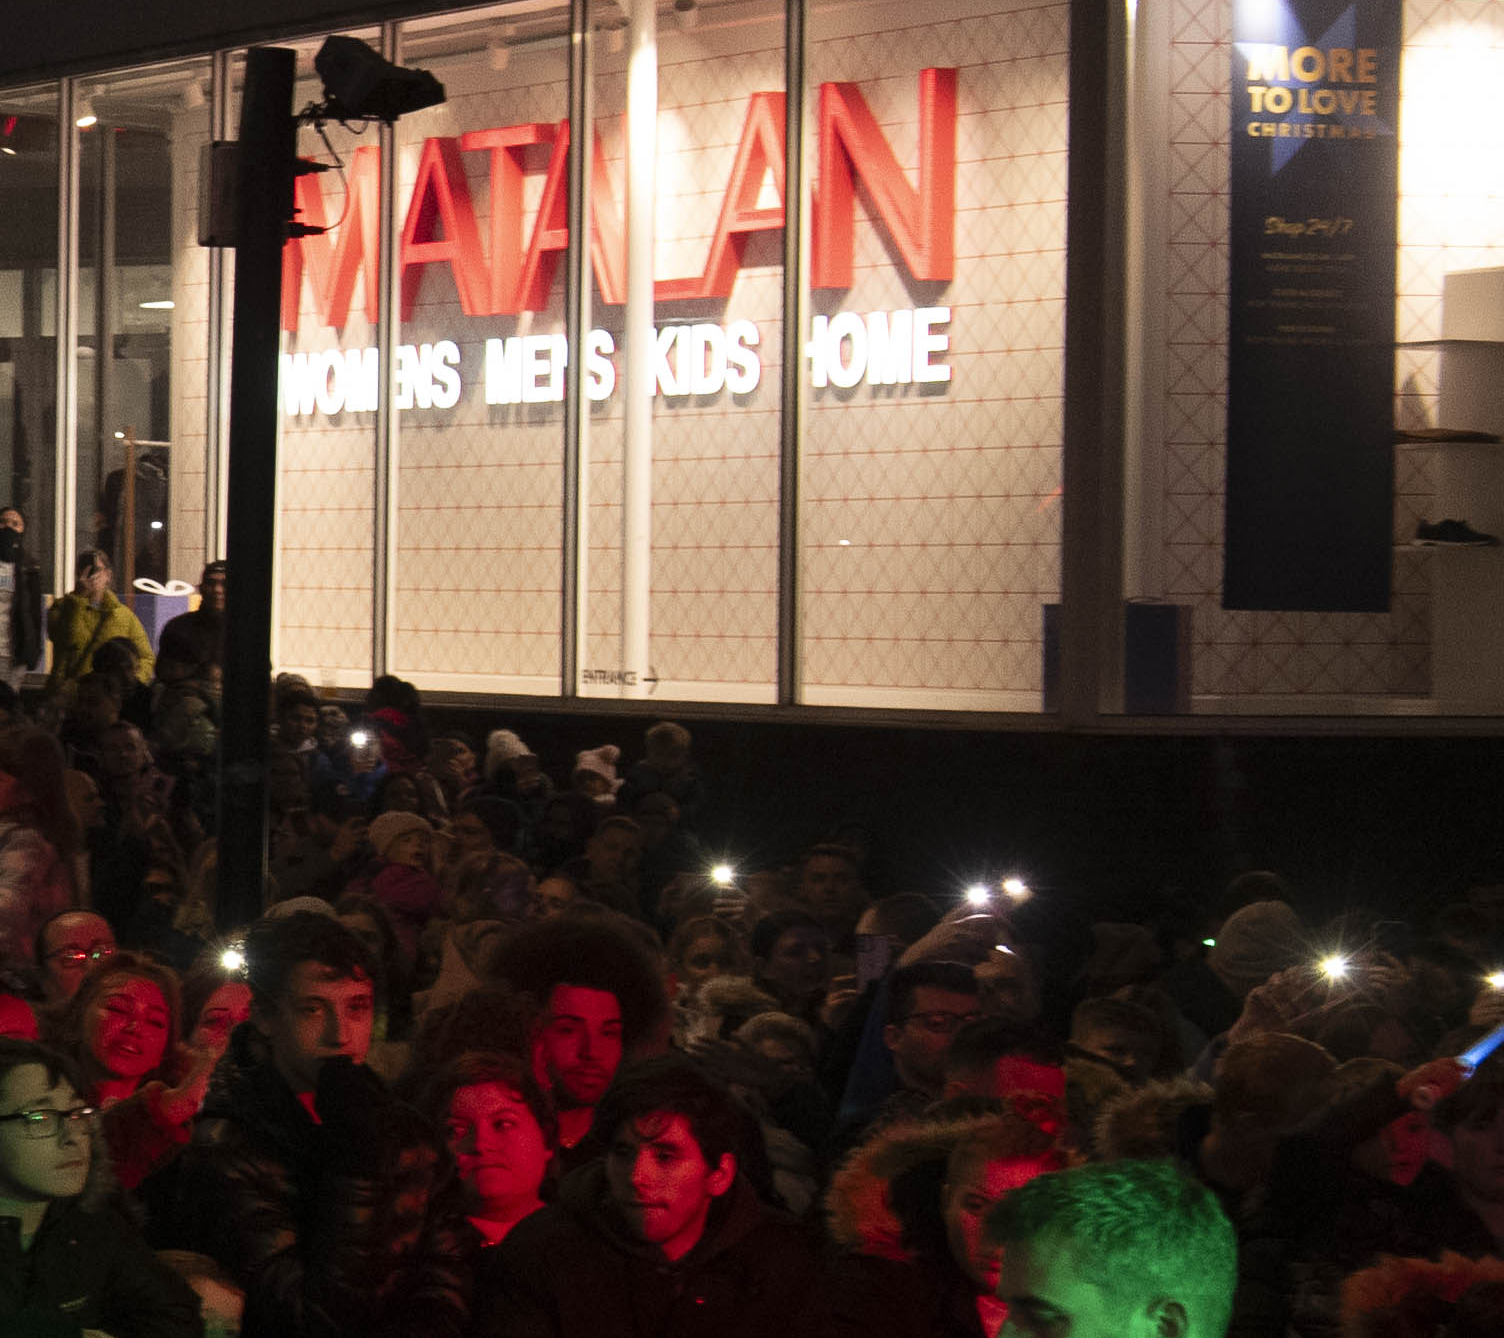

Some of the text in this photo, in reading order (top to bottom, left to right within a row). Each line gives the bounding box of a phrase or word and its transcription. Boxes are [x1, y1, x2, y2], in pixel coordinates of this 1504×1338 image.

[1249, 46, 1377, 83] MORE
[1248, 87, 1377, 115] TO LOVE
[1247, 122, 1377, 140] CHRISTMAS
[282, 67, 958, 331] MATAAN
[279, 339, 461, 417] WOMENS
[648, 322, 760, 398] KIDS
[806, 306, 952, 388] HOME
